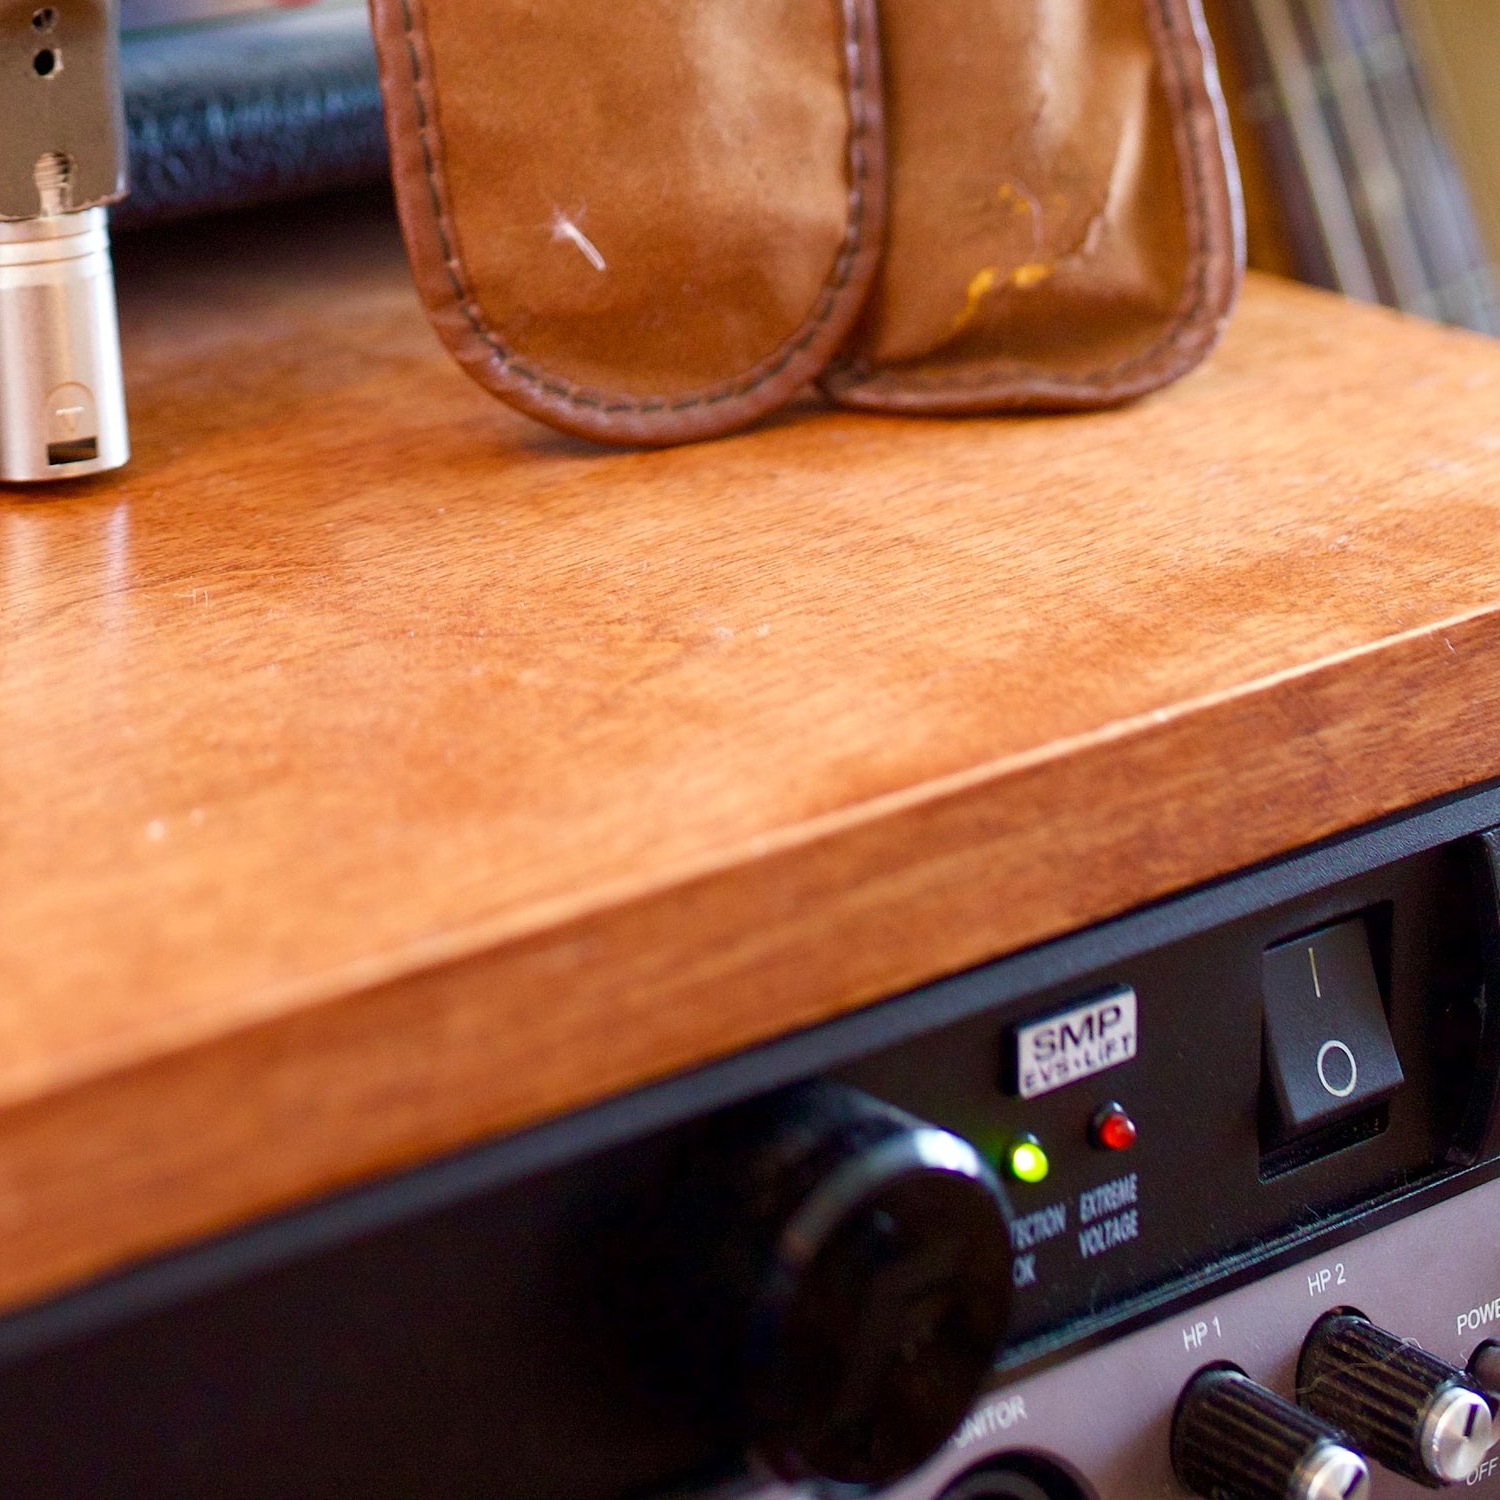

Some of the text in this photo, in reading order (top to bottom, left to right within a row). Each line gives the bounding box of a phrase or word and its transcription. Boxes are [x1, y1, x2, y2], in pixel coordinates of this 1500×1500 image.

[1032, 1005, 1122, 1063] SMP
[1079, 1173, 1138, 1222] EXTREME
[1013, 1209, 1138, 1288] OK VOLTAGE
[1306, 1262, 1347, 1297] HP 2
[1182, 1315, 1222, 1351] HP 1
[950, 1395, 1028, 1449] ONITOR
[1465, 1455, 1499, 1487] OFF
